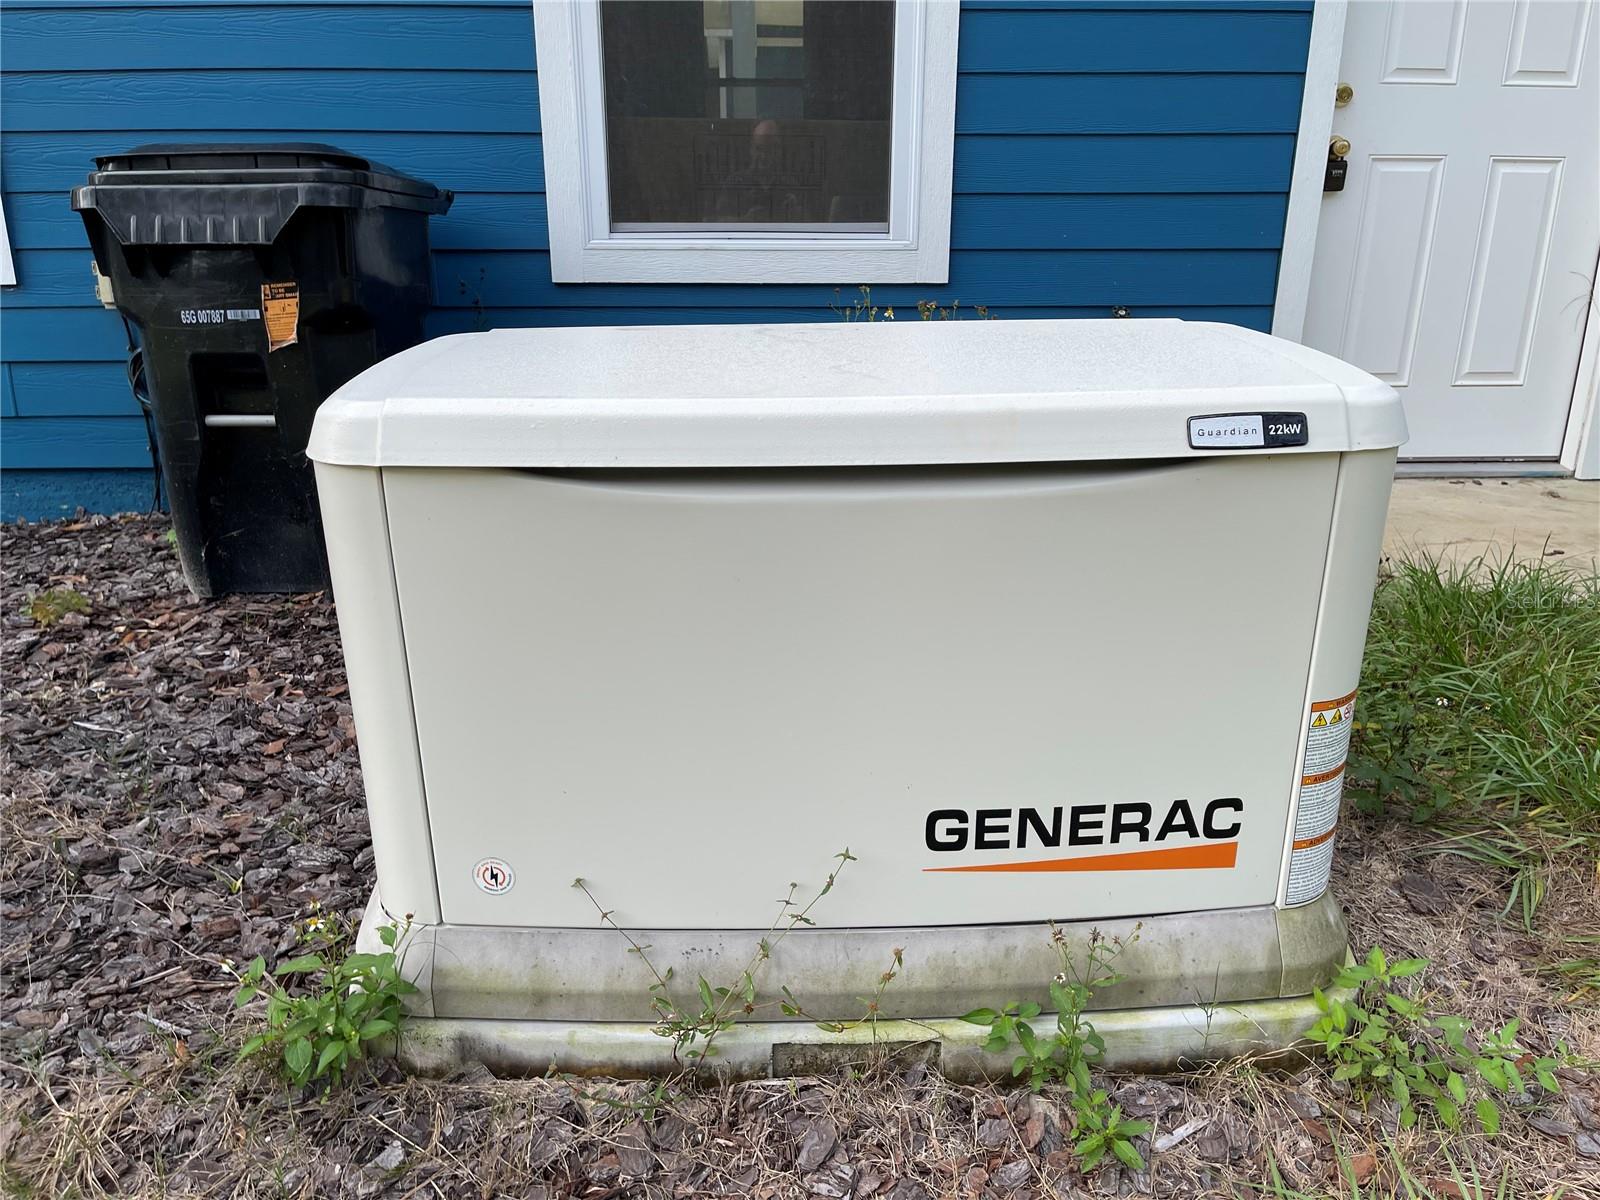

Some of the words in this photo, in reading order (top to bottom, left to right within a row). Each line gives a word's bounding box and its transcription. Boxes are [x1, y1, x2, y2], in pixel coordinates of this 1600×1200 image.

[180, 310, 196, 324] 65G
[197, 310, 225, 324] 007887
[1197, 427, 1258, 437] Guardian
[1268, 423, 1302, 435] 22kW
[925, 797, 1244, 852] GENERAC
